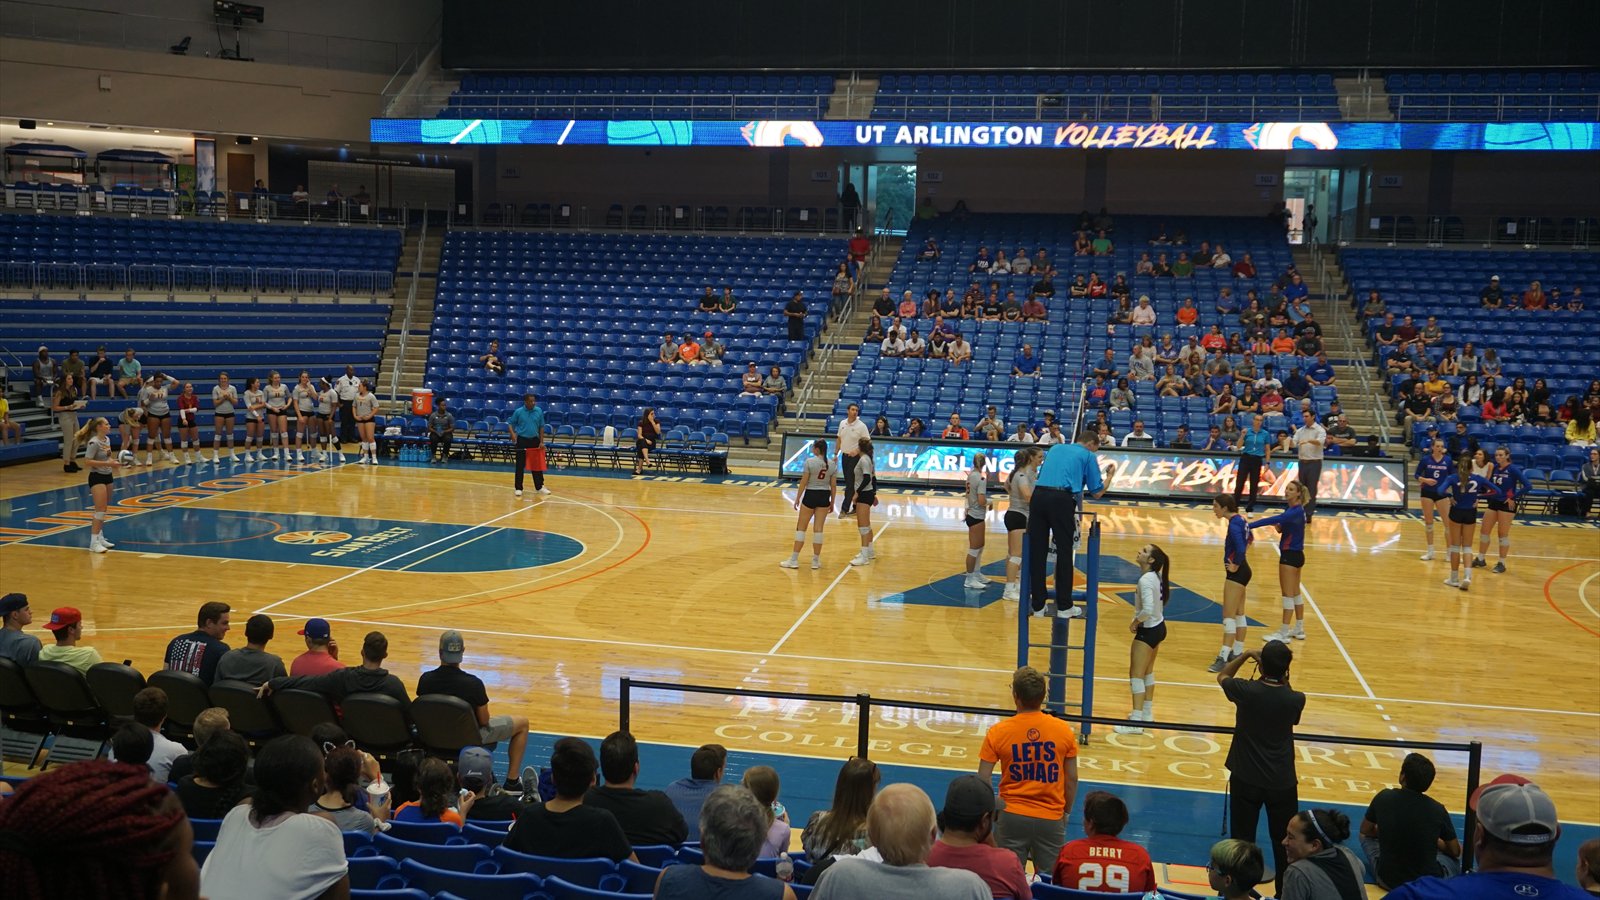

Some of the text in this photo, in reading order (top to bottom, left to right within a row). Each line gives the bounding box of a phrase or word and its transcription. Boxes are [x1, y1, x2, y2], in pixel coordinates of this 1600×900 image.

[855, 122, 1217, 149] UT ARLINGTON VOLLEYBALL
[888, 453, 915, 469] UT
[817, 468, 827, 481] 6
[1433, 470, 1441, 479] 6
[714, 724, 967, 759] COLLEGE
[1011, 741, 1056, 763] LETS
[1105, 731, 1394, 770] CORT
[1009, 762, 1059, 784] SHAG
[1089, 846, 1122, 859] BERRY
[1078, 862, 1130, 893] 29
